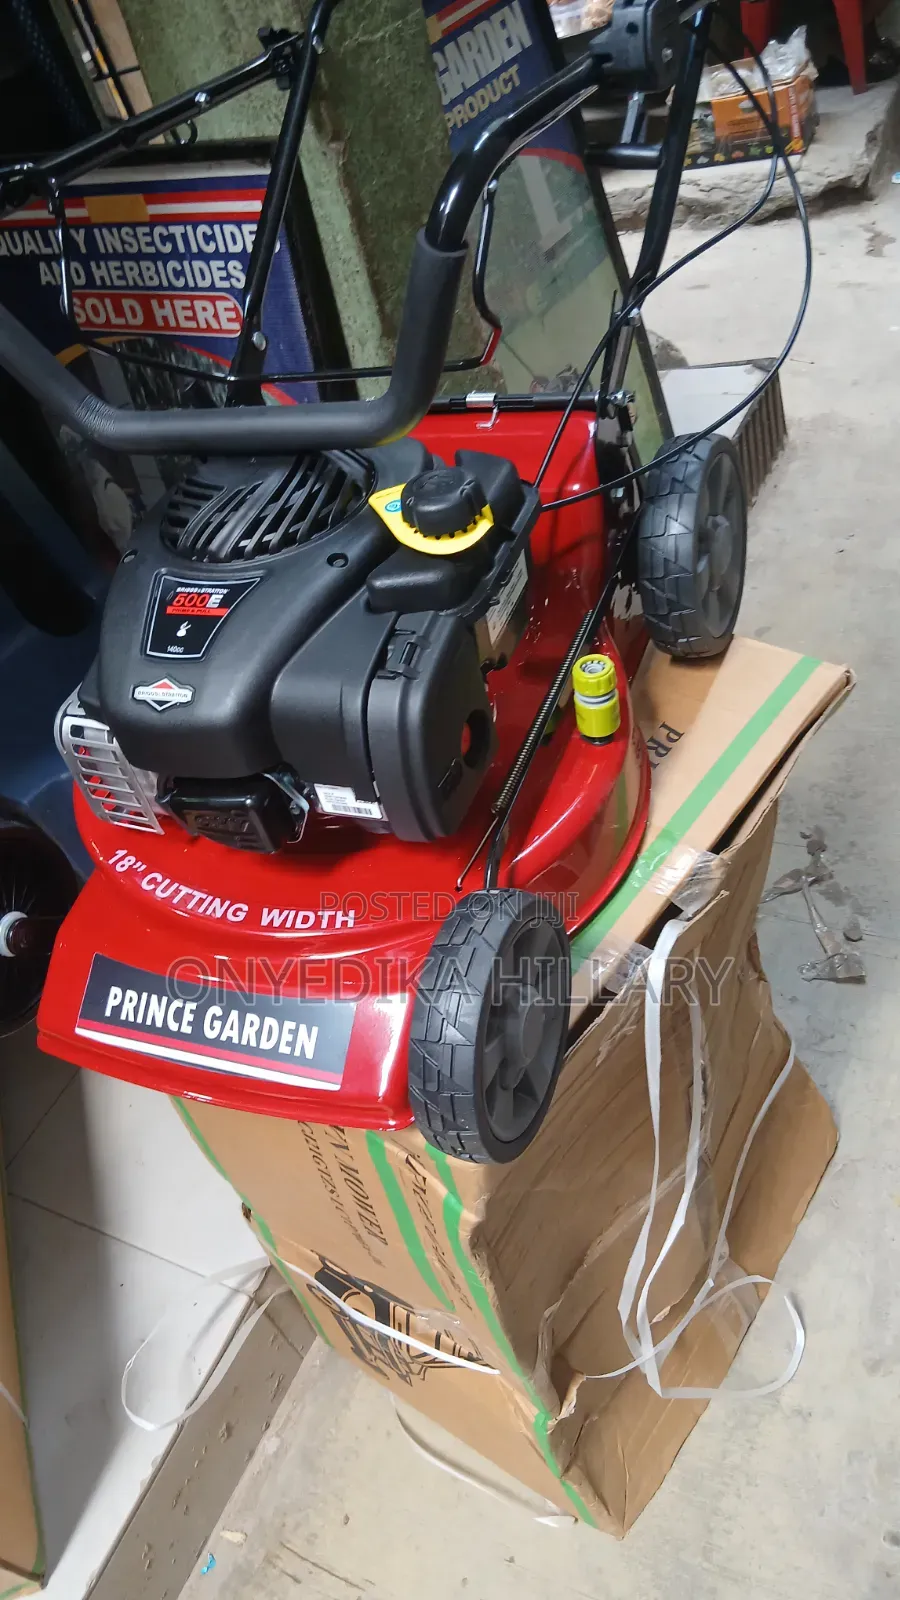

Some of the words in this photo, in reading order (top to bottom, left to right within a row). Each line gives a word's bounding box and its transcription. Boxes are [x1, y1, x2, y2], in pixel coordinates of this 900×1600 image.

[432, 0, 532, 106] GARDEN
[444, 63, 521, 135] PRODUCT
[0, 228, 87, 257] QUALIY
[99, 223, 281, 255] INSECTICIDE
[91, 259, 247, 289] HERBICIDES
[73, 296, 143, 327] SOLD
[154, 298, 242, 331] HERE
[140, 871, 250, 923] CUTTING
[259, 907, 356, 930] WIDTH
[104, 985, 197, 1036] PRINCE
[202, 1004, 320, 1061] GARDEN
